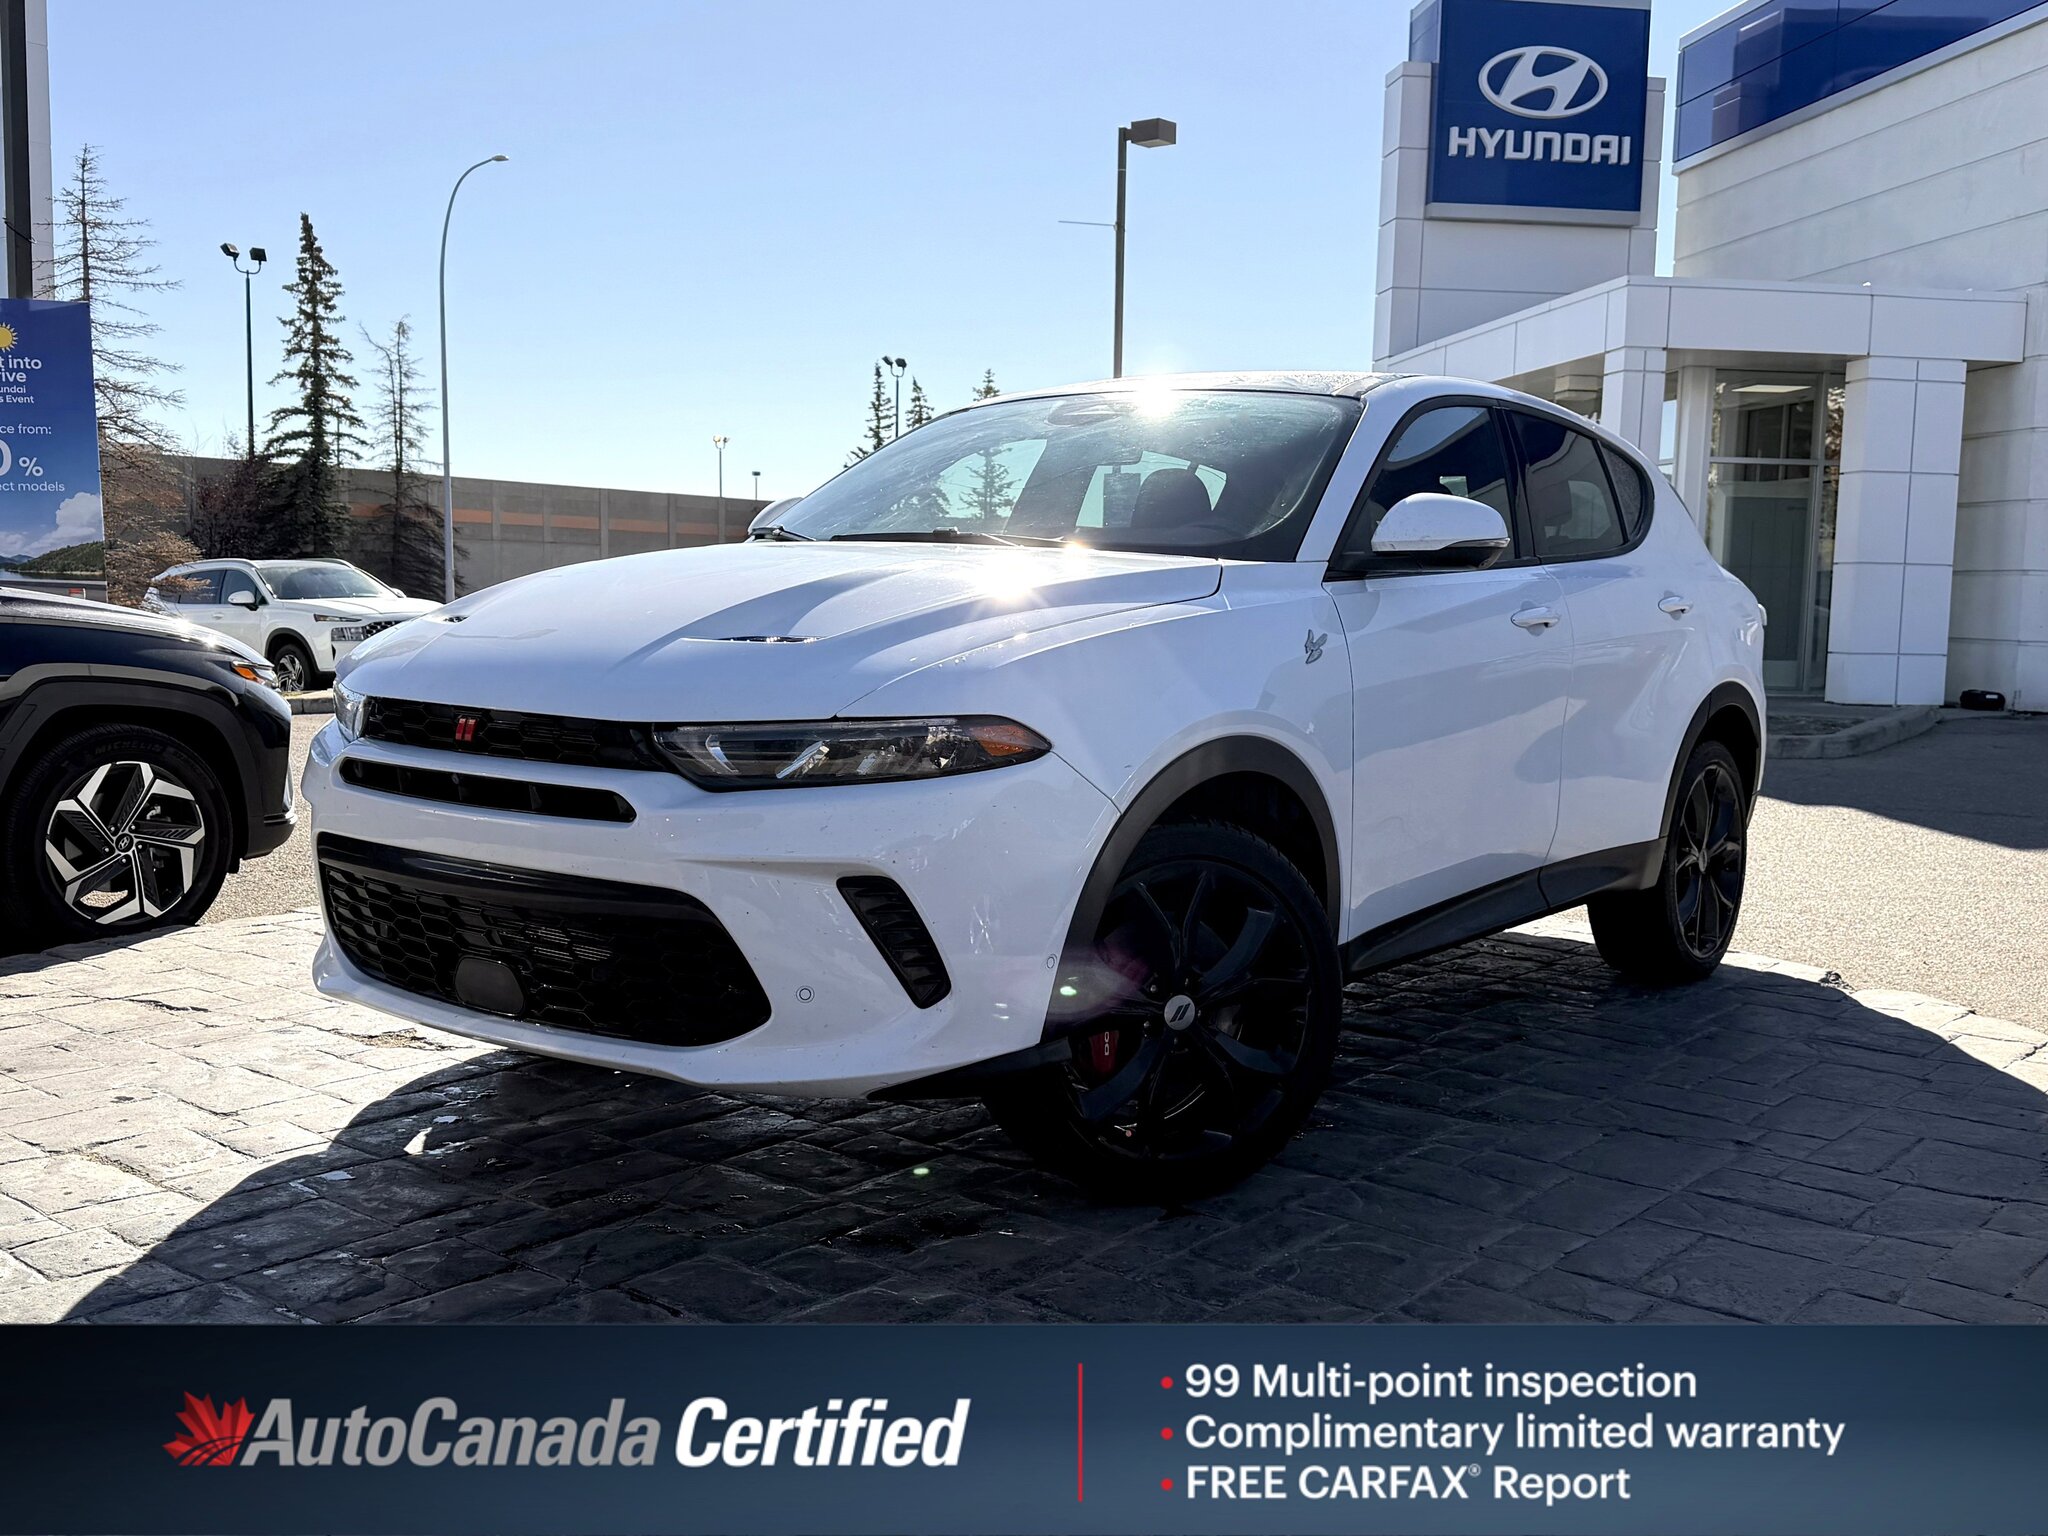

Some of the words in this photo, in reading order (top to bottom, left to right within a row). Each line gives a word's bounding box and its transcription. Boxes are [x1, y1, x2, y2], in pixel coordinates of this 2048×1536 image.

[1448, 126, 1631, 166] HYUNDAI
[8, 354, 42, 369] into
[0, 368, 27, 382] ive
[6, 395, 35, 404] Event
[18, 423, 52, 435] from:
[18, 481, 65, 492] models
